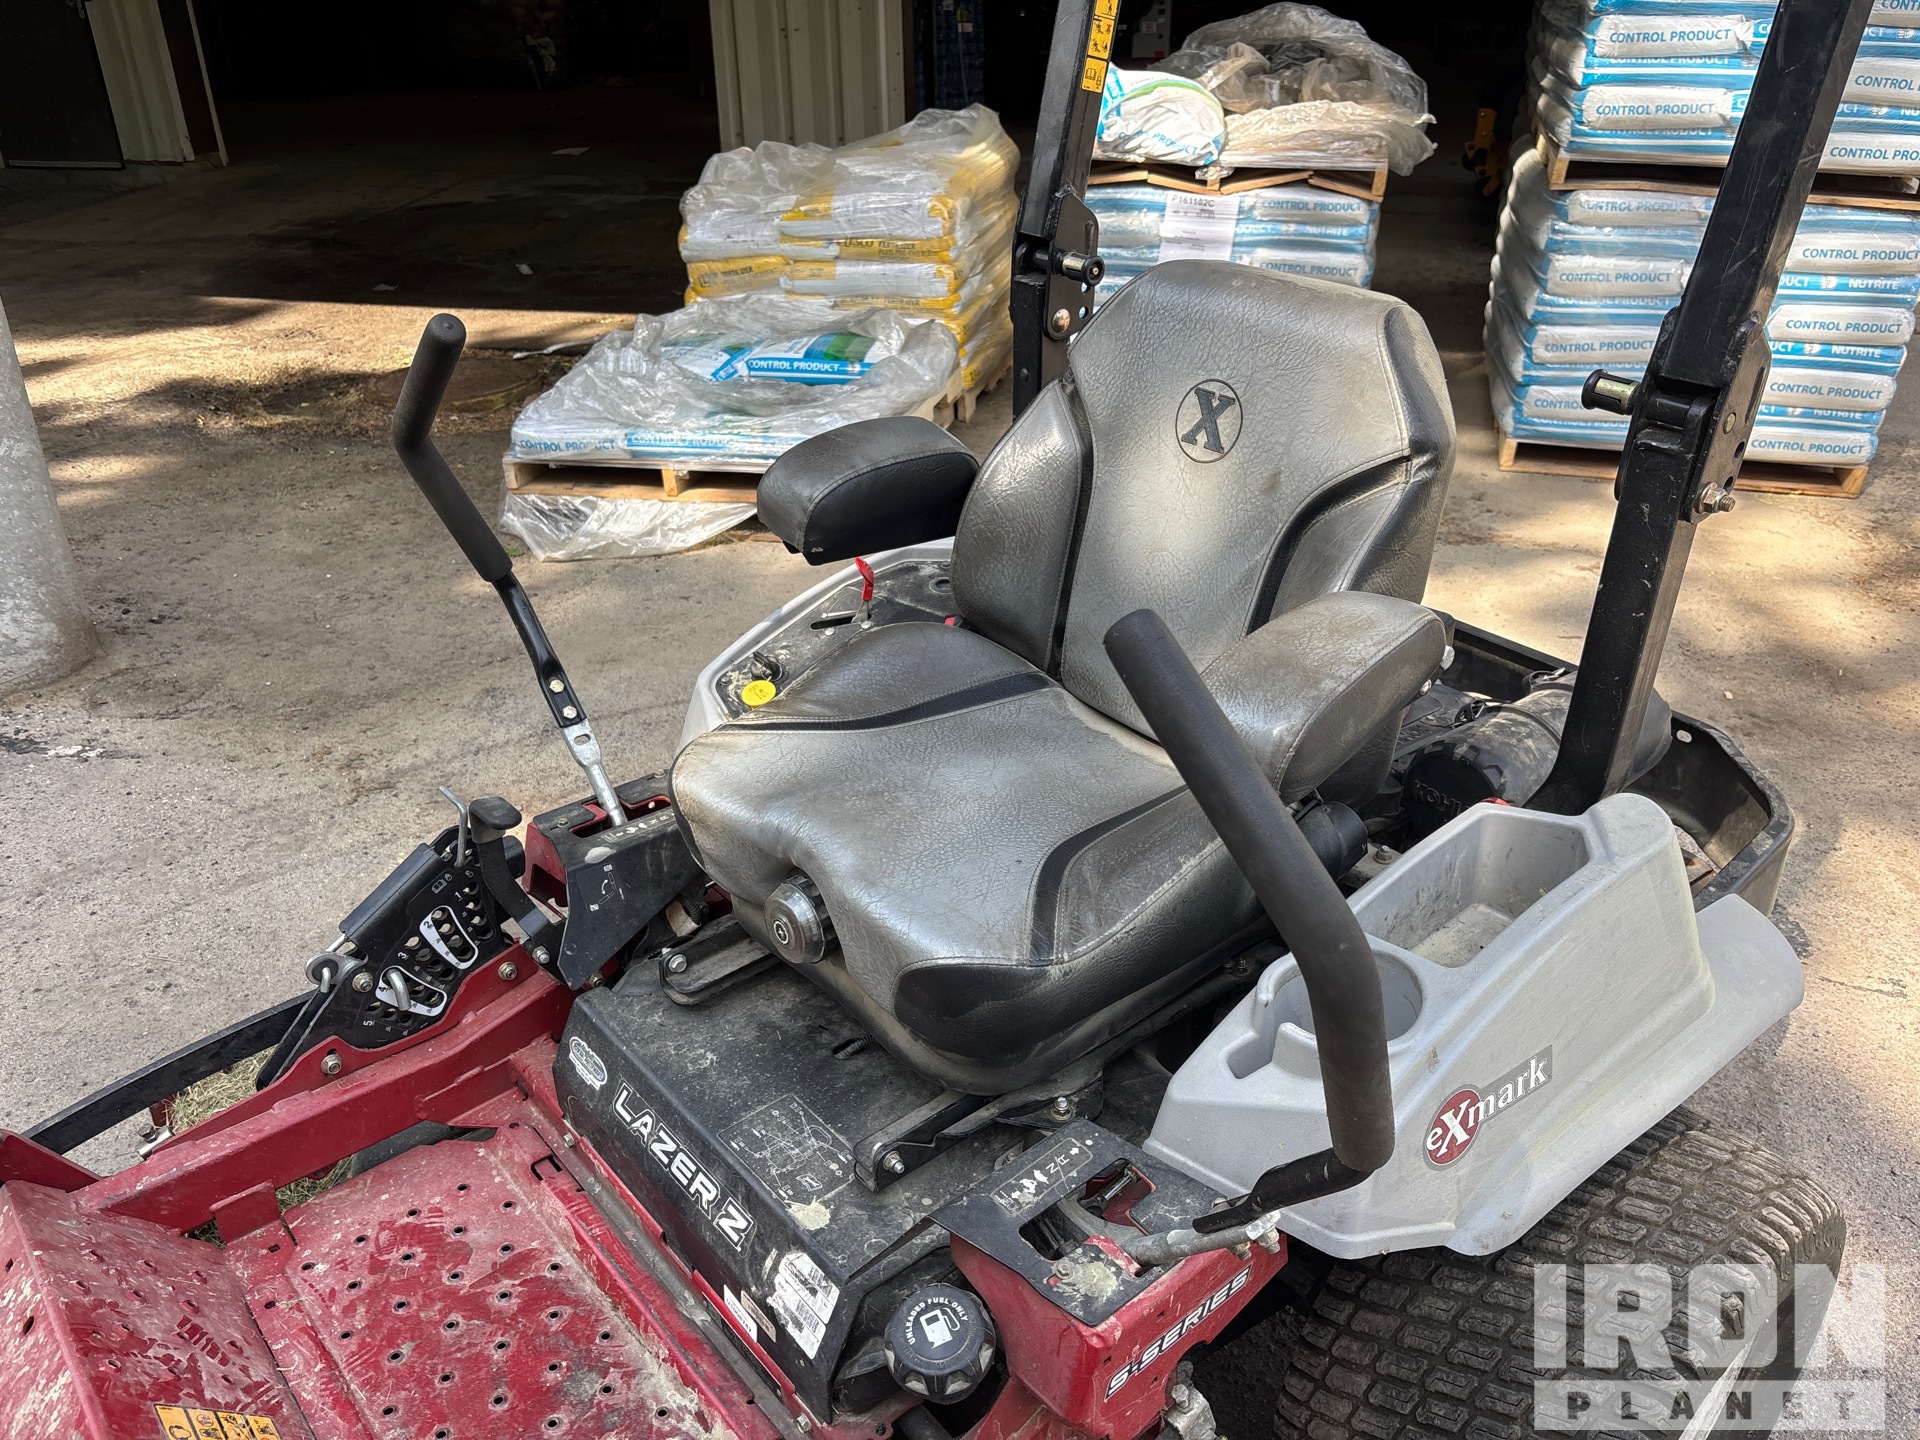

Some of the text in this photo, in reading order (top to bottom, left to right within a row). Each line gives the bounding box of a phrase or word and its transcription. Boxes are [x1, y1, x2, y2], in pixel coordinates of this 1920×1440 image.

[1610, 29, 1731, 43] CONTROL PRODUCT
[1855, 75, 1914, 90] CONTROL
[1596, 103, 1714, 116] CONTROL PRODUCT
[1830, 147, 1889, 160] CONTROL
[1262, 200, 1361, 212] CONTROL PRODUCT
[1802, 248, 1920, 261] CONTROL PRODUCT
[1260, 262, 1359, 277] CONTROL PRODUCT
[1559, 273, 1672, 283] CONTROL PRODUCT
[1848, 279, 1899, 290] NUTRITE
[1786, 319, 1902, 333] CONTROL PRODUCT
[1544, 340, 1655, 353] CONTROL PRODUCT
[1831, 344, 1881, 358] NUTRITE
[749, 359, 839, 372] CONTROL PRODUCT
[1770, 382, 1882, 400] CONTROL PRODUCT
[1181, 387, 1236, 454] X
[520, 439, 562, 452] CONTROL
[1751, 439, 1864, 455] CONTROL PRODUCT
[1426, 1056, 1548, 1157] eXmark
[614, 1089, 717, 1210] LAZER
[714, 1203, 750, 1244] Z
[905, 1297, 969, 1346] UNLEADED FUEL ONLY
[1105, 1264, 1252, 1400] S-SERIES
